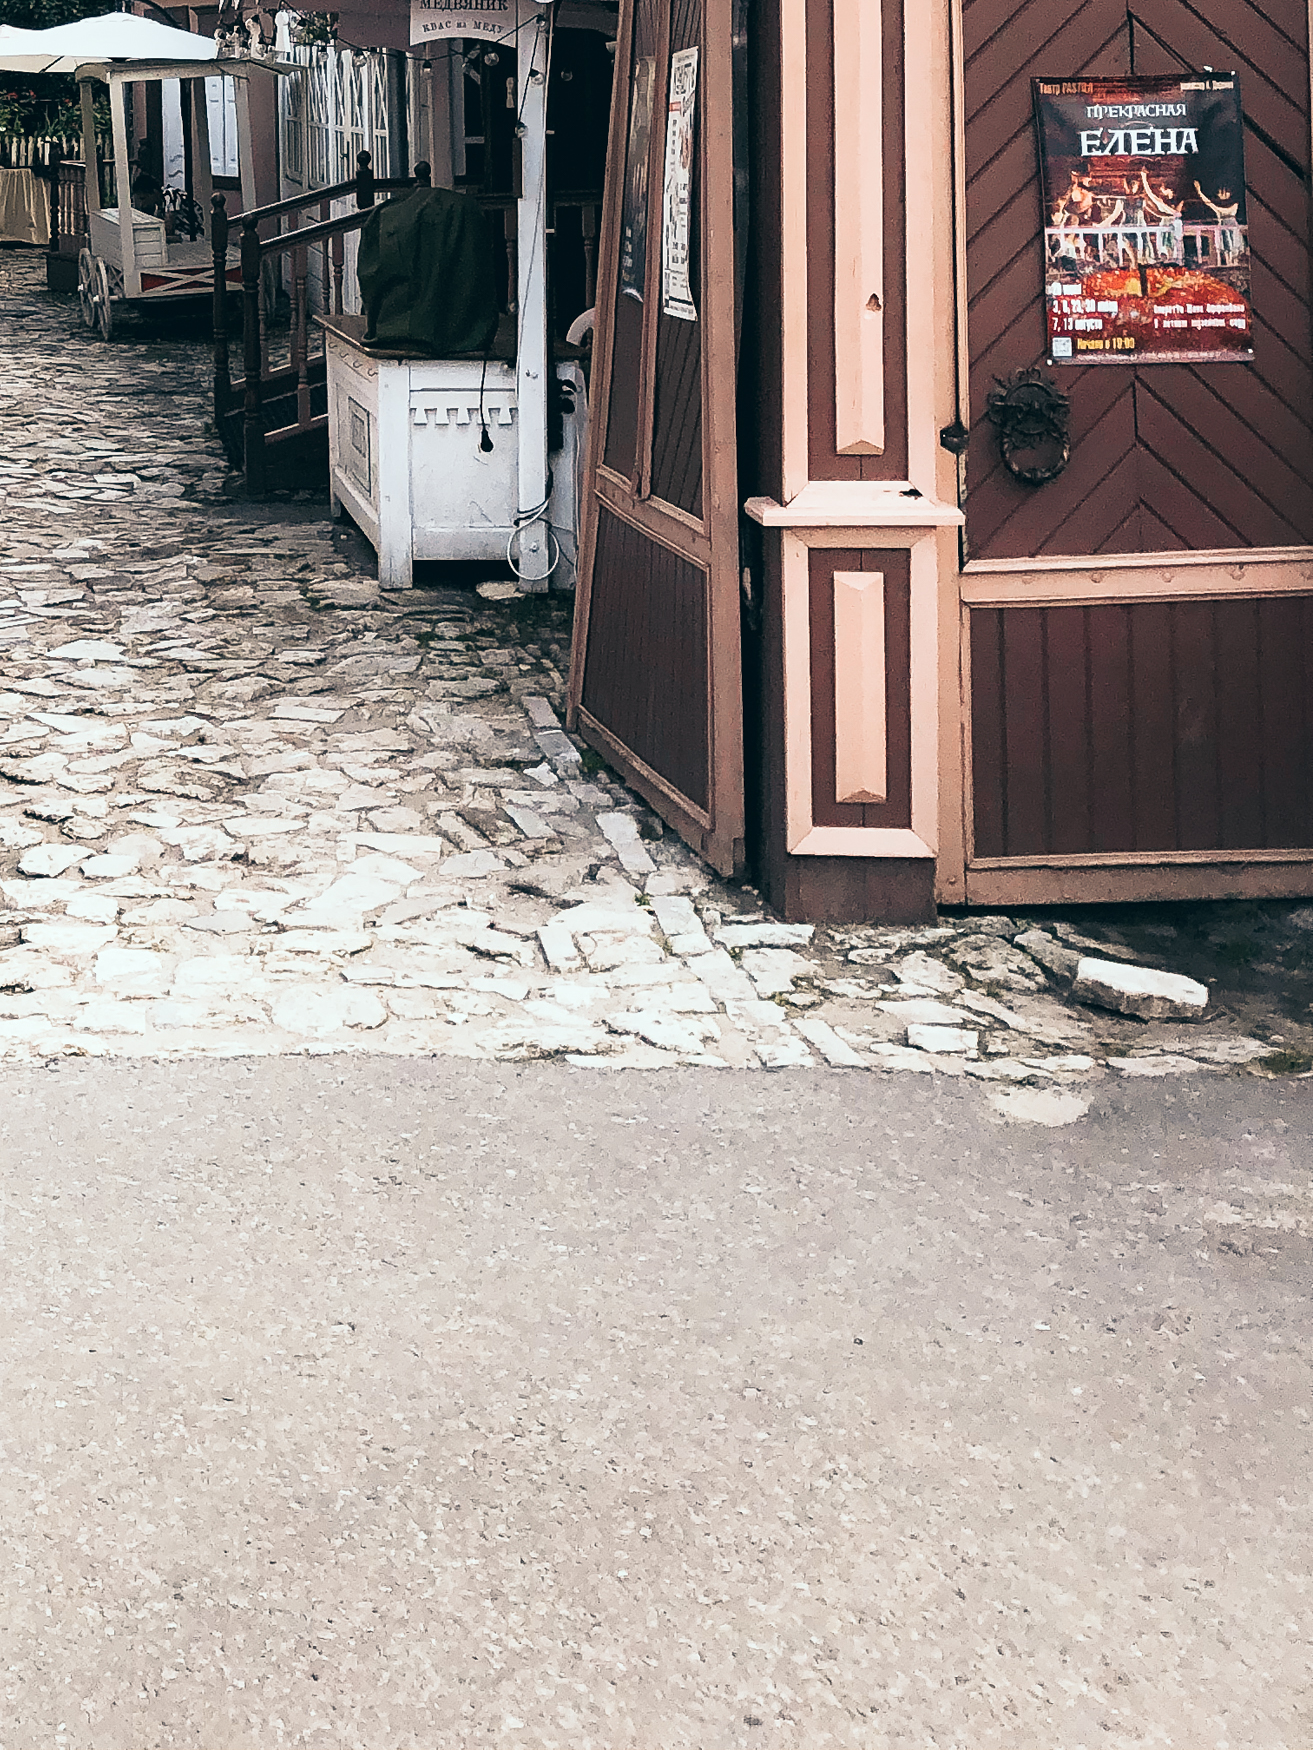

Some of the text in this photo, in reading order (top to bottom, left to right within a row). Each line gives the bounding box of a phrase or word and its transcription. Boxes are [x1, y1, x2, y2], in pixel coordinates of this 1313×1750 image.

[422, 20, 452, 33] КВАС
[473, 20, 505, 34] МЕДУ
[1086, 104, 1187, 119] ПРЕКРАСНАЯ
[1078, 127, 1199, 157] ЕЛЕНА
